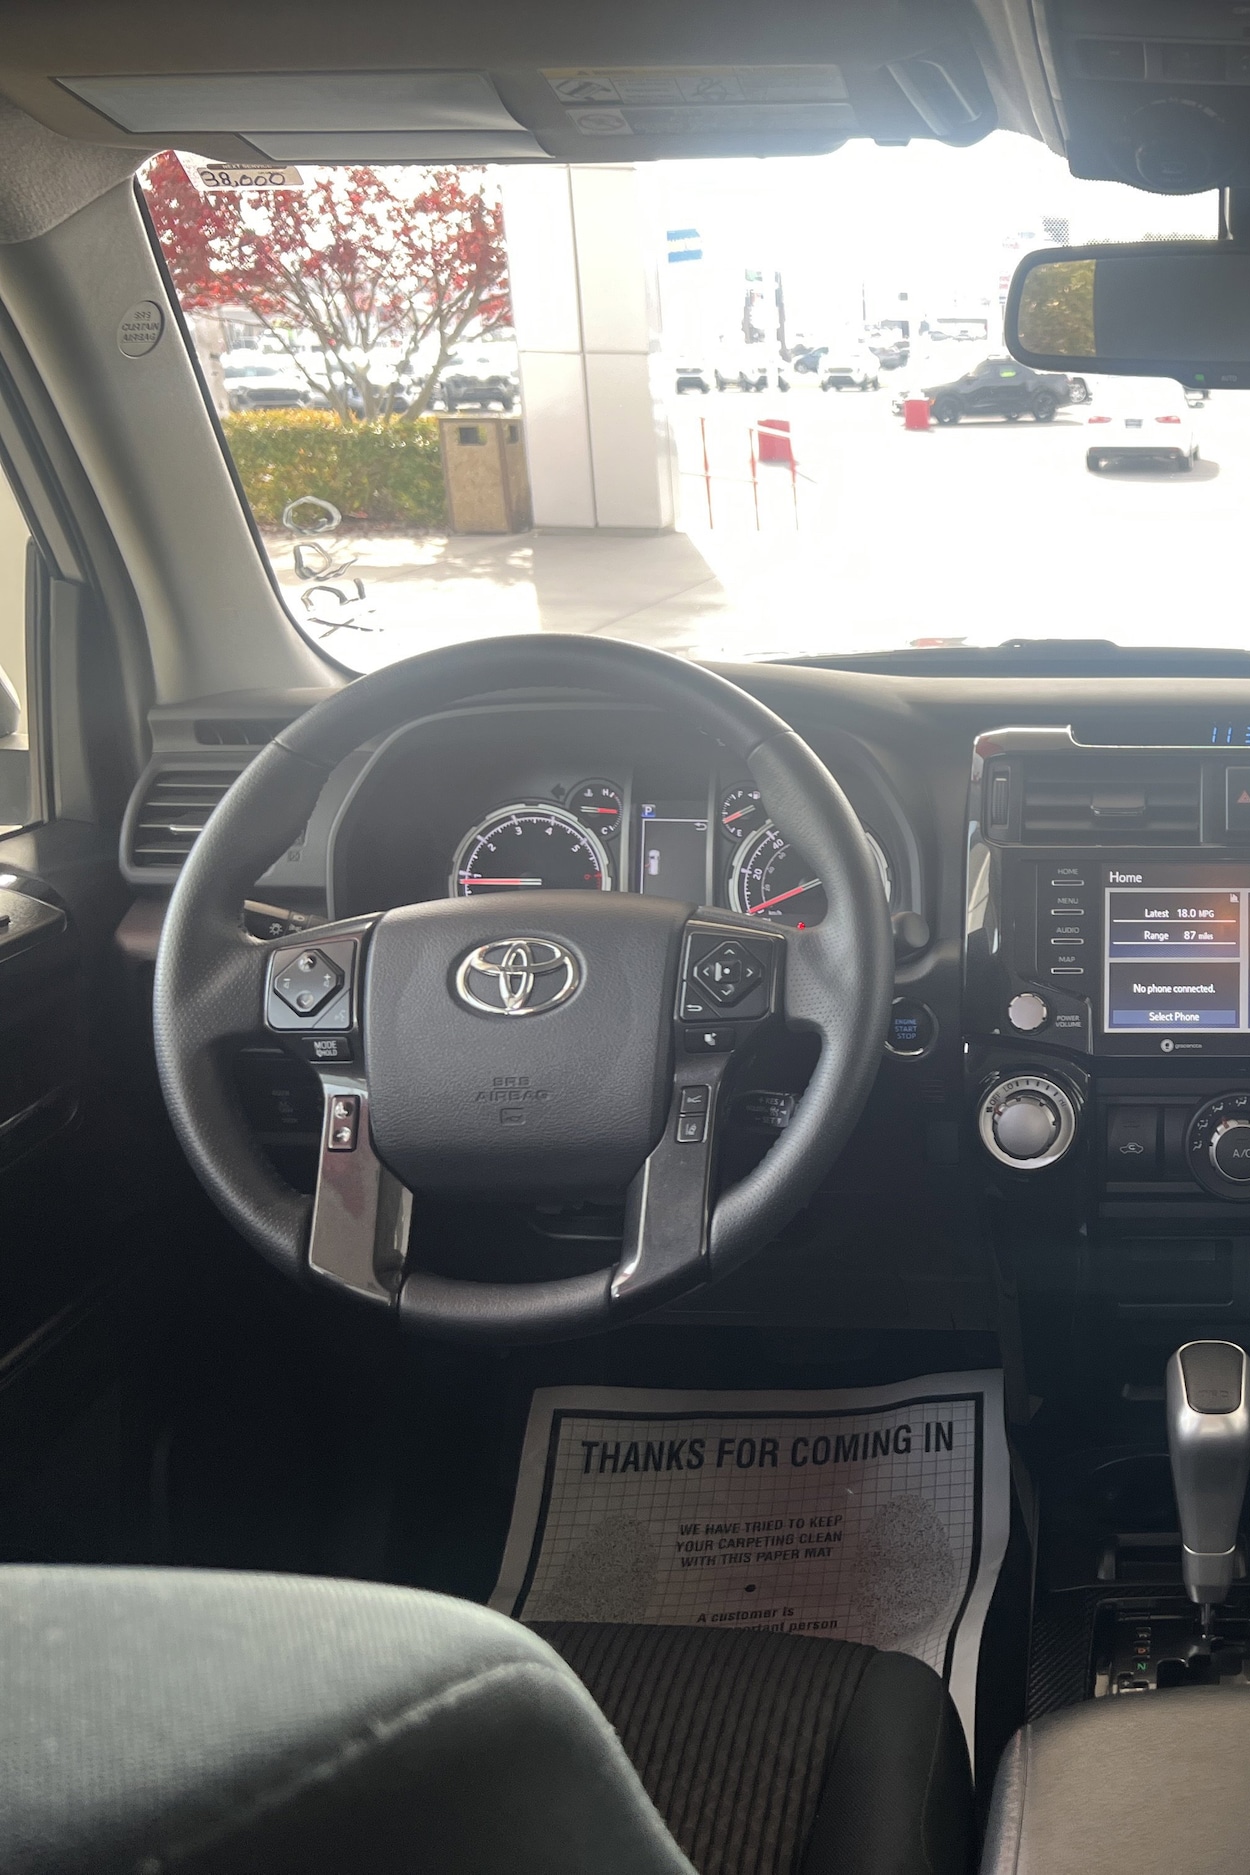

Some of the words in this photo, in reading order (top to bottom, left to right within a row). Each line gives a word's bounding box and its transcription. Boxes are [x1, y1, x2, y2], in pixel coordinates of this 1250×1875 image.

[545, 828, 553, 836] 4
[487, 843, 497, 853] 2
[571, 844, 580, 853] 5
[772, 839, 784, 850] 40
[753, 868, 763, 881] 20
[1109, 871, 1143, 883] Home
[1144, 908, 1170, 918] Latest
[1177, 908, 1197, 918] 18.0
[1198, 909, 1215, 918] MPG
[1144, 930, 1170, 941] Range
[1183, 930, 1197, 940] 87
[1198, 931, 1214, 940] miles
[1133, 983, 1147, 993] No
[1147, 983, 1172, 995] phone
[1173, 983, 1216, 994] connected.
[1148, 1011, 1173, 1022] Select
[1174, 1011, 1200, 1022] Phone
[314, 1040, 337, 1049] MODE
[1003, 1082, 1014, 1092] LO
[475, 1090, 551, 1101] AIRBAG
[581, 1439, 706, 1475] THANKS
[716, 1437, 779, 1469] FOR
[791, 1424, 912, 1467] COMING
[925, 1421, 954, 1453] IN
[680, 1524, 701, 1536] WE
[705, 1522, 741, 1535] HAVE
[745, 1519, 784, 1533] TRIED
[788, 1518, 805, 1529] TO
[809, 1514, 843, 1528] KEEP
[676, 1540, 714, 1553] YOUR
[718, 1533, 795, 1550] CARPETING
[800, 1530, 843, 1544] CLEAN
[681, 1556, 716, 1568] WITH
[722, 1553, 752, 1565] THIS
[756, 1549, 800, 1562] PAPER
[804, 1547, 834, 1559] MAT
[696, 1612, 706, 1623] A
[711, 1607, 778, 1622] customer
[782, 1606, 795, 1617] is
[789, 1619, 838, 1633] person
[1137, 1662, 1147, 1670] N
